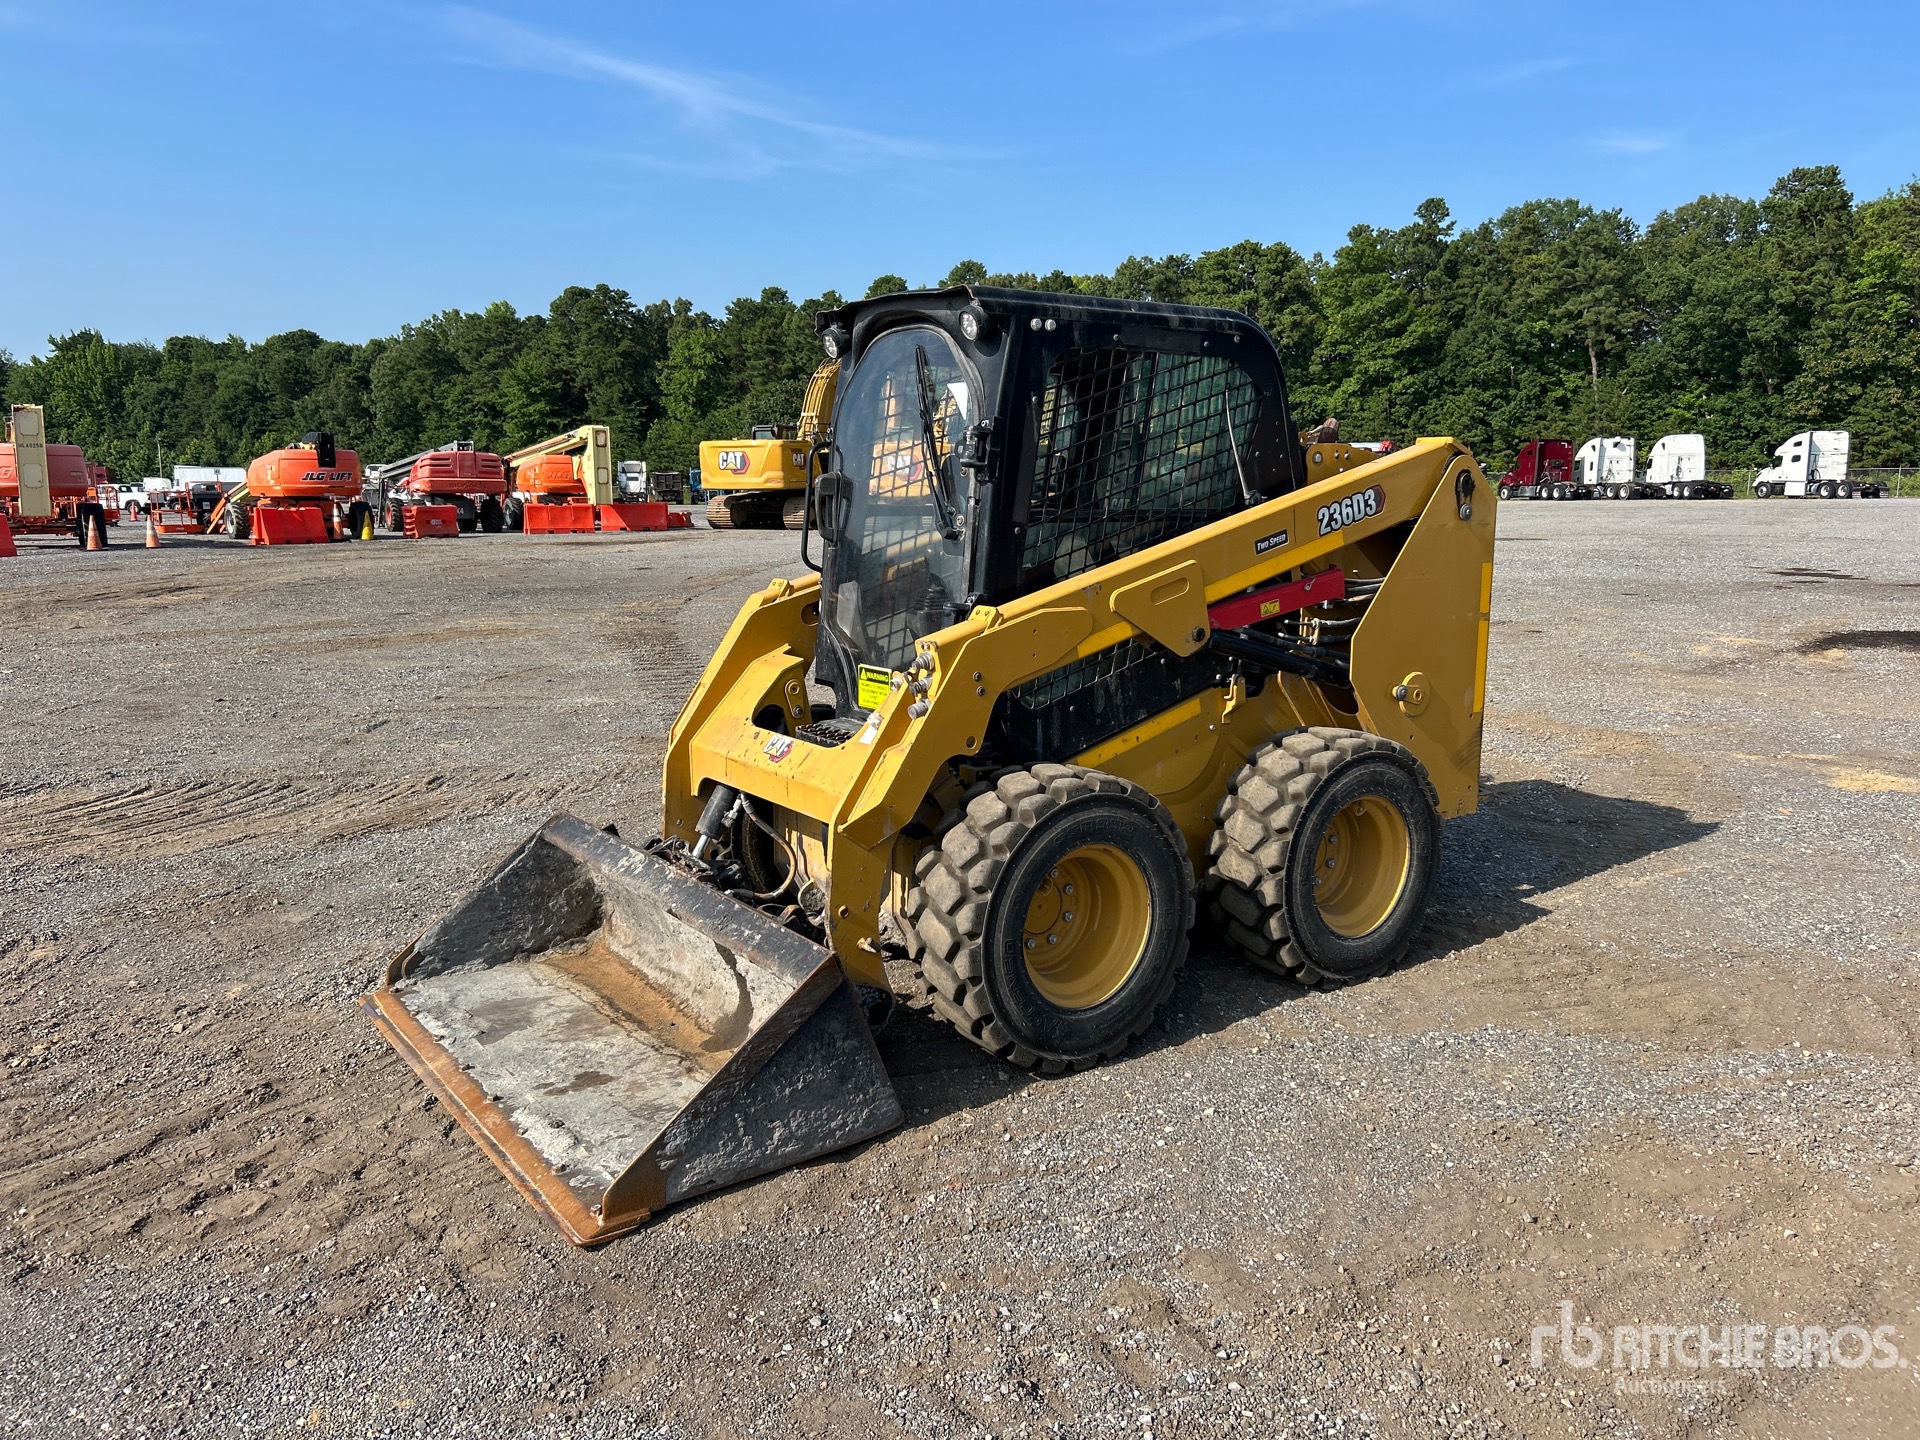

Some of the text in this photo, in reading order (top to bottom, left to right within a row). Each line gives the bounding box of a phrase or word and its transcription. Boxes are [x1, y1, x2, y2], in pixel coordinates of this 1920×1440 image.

[719, 451, 742, 470] CAT
[793, 453, 805, 467] CAT
[301, 472, 353, 481] JLG LIFT
[1111, 498, 1130, 510] CAT
[1318, 488, 1377, 535] 236D3
[867, 671, 889, 682] WARNING
[763, 734, 790, 758] CAT
